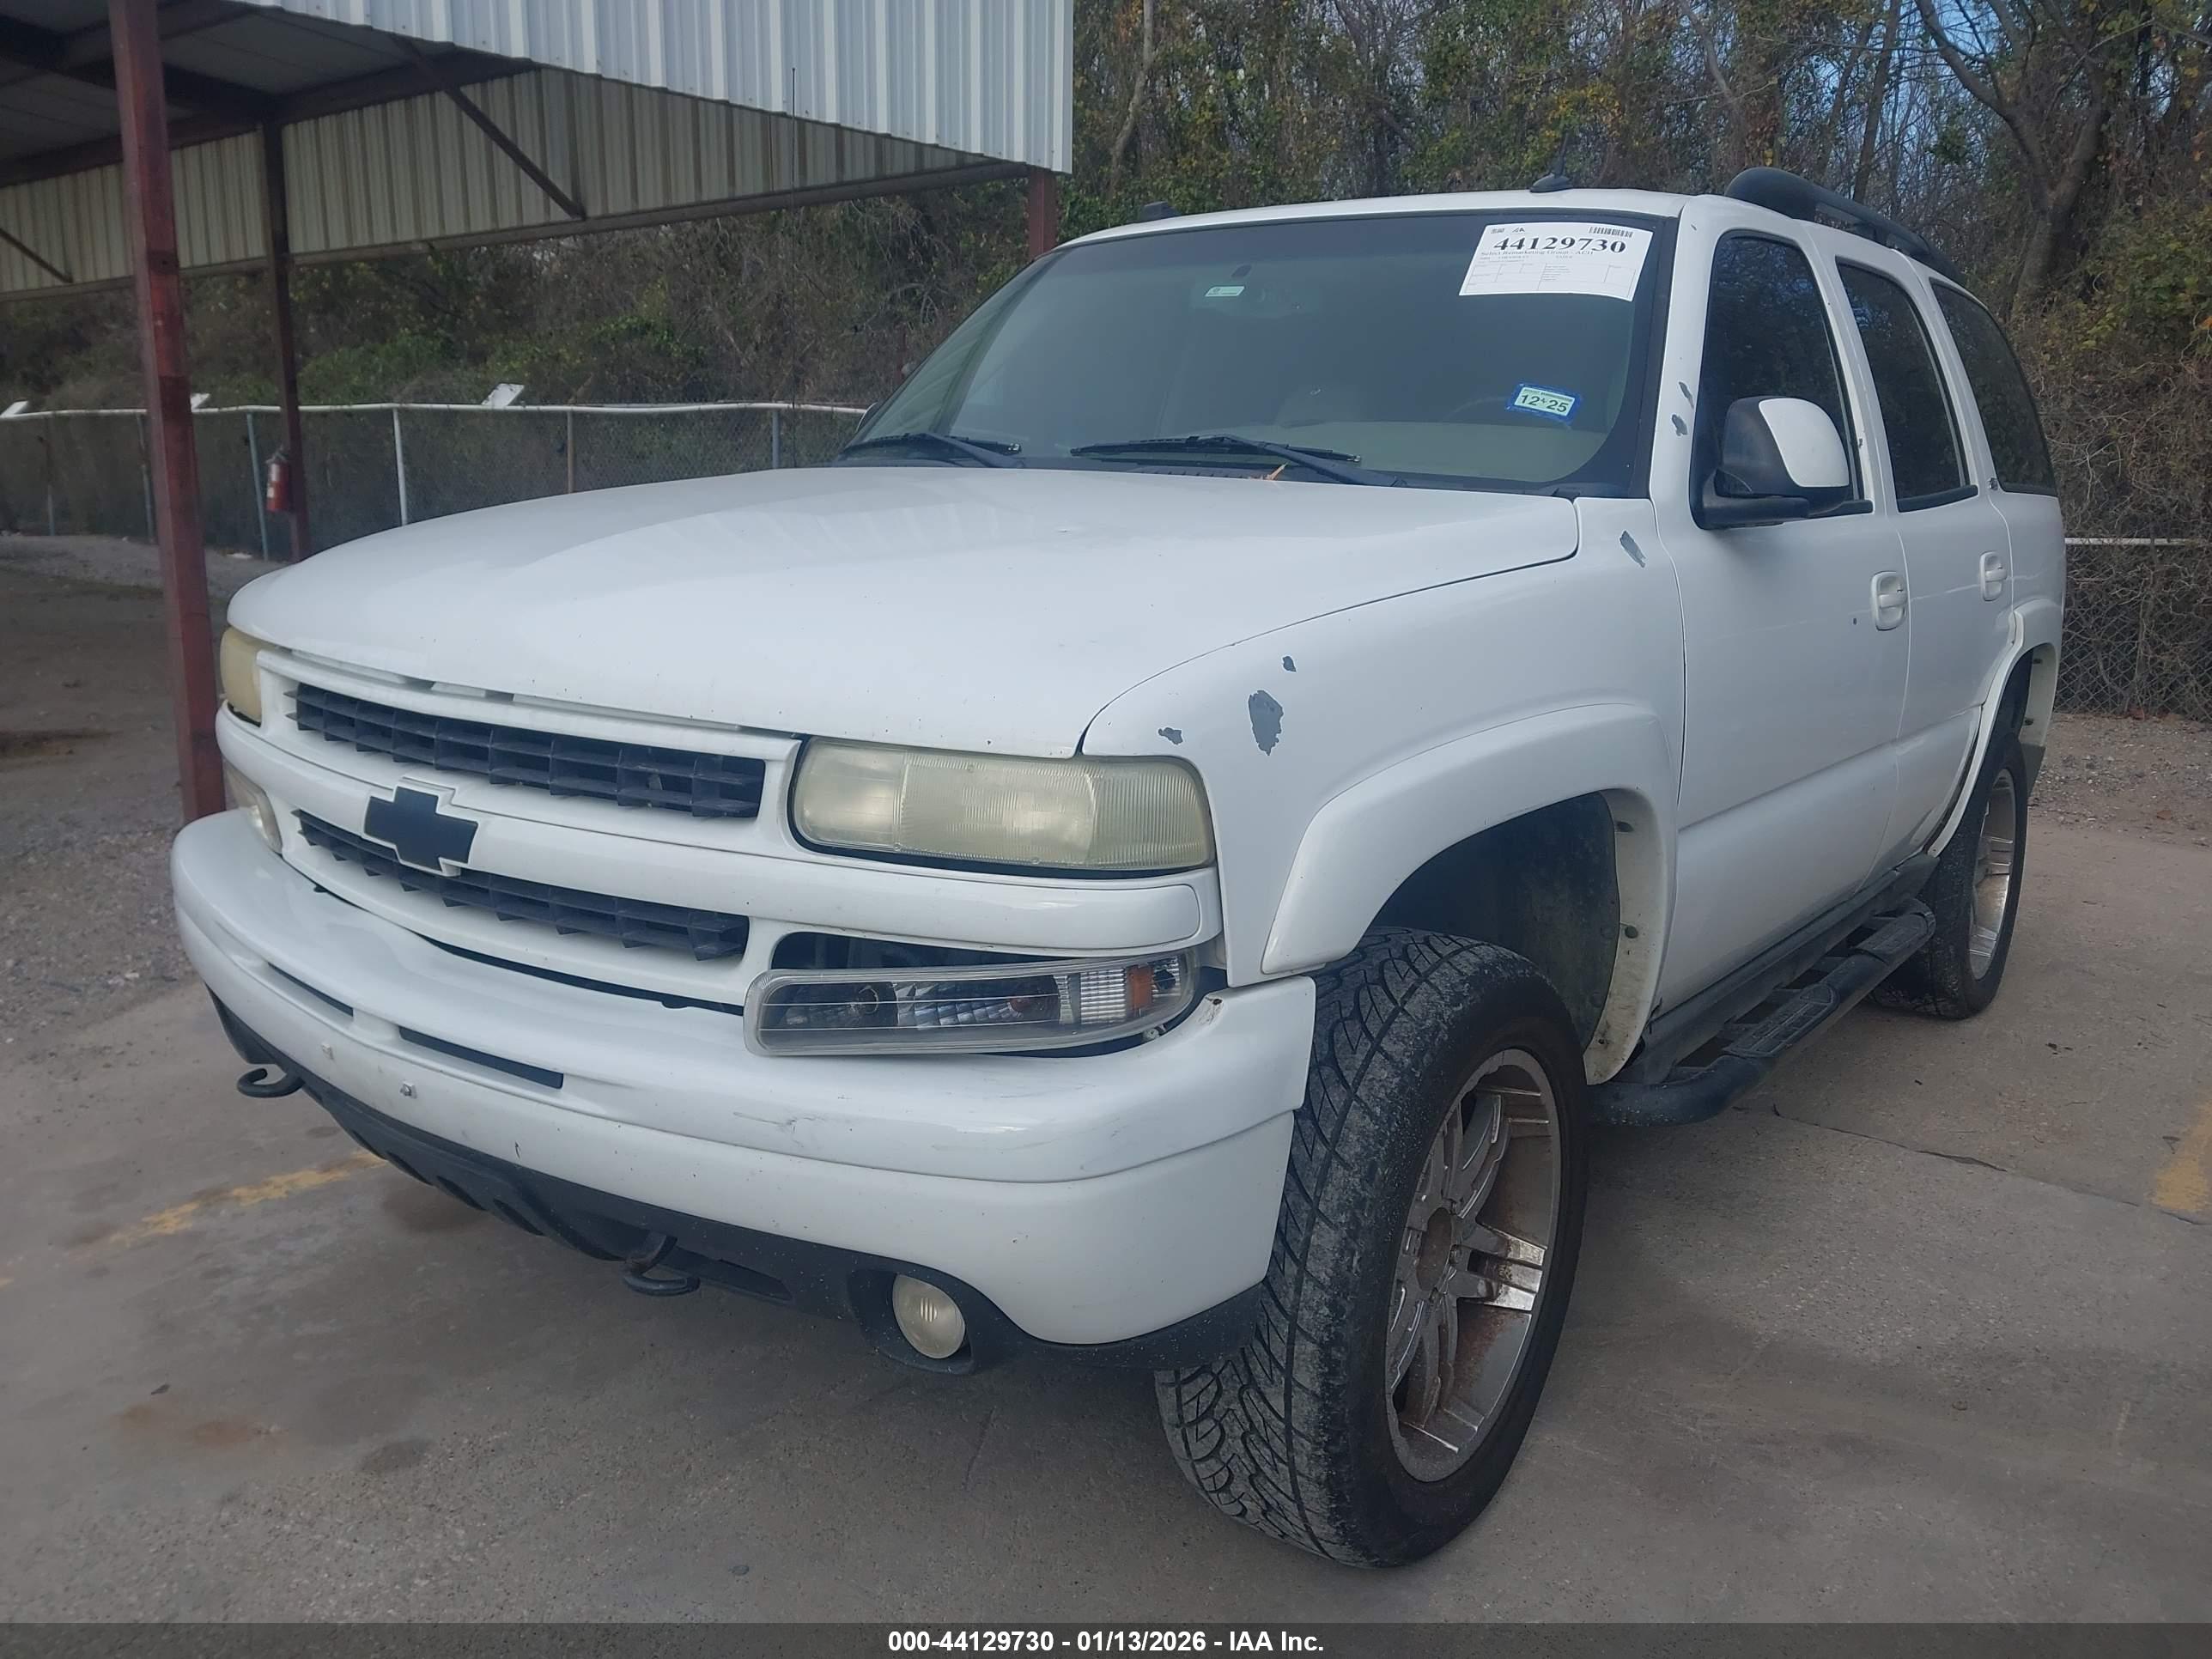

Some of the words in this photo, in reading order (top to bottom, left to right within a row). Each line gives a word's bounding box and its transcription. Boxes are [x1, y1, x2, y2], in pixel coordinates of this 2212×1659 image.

[1493, 236, 1626, 254] 44129730
[1521, 394, 1540, 406] 12
[1546, 399, 1569, 412] 25
